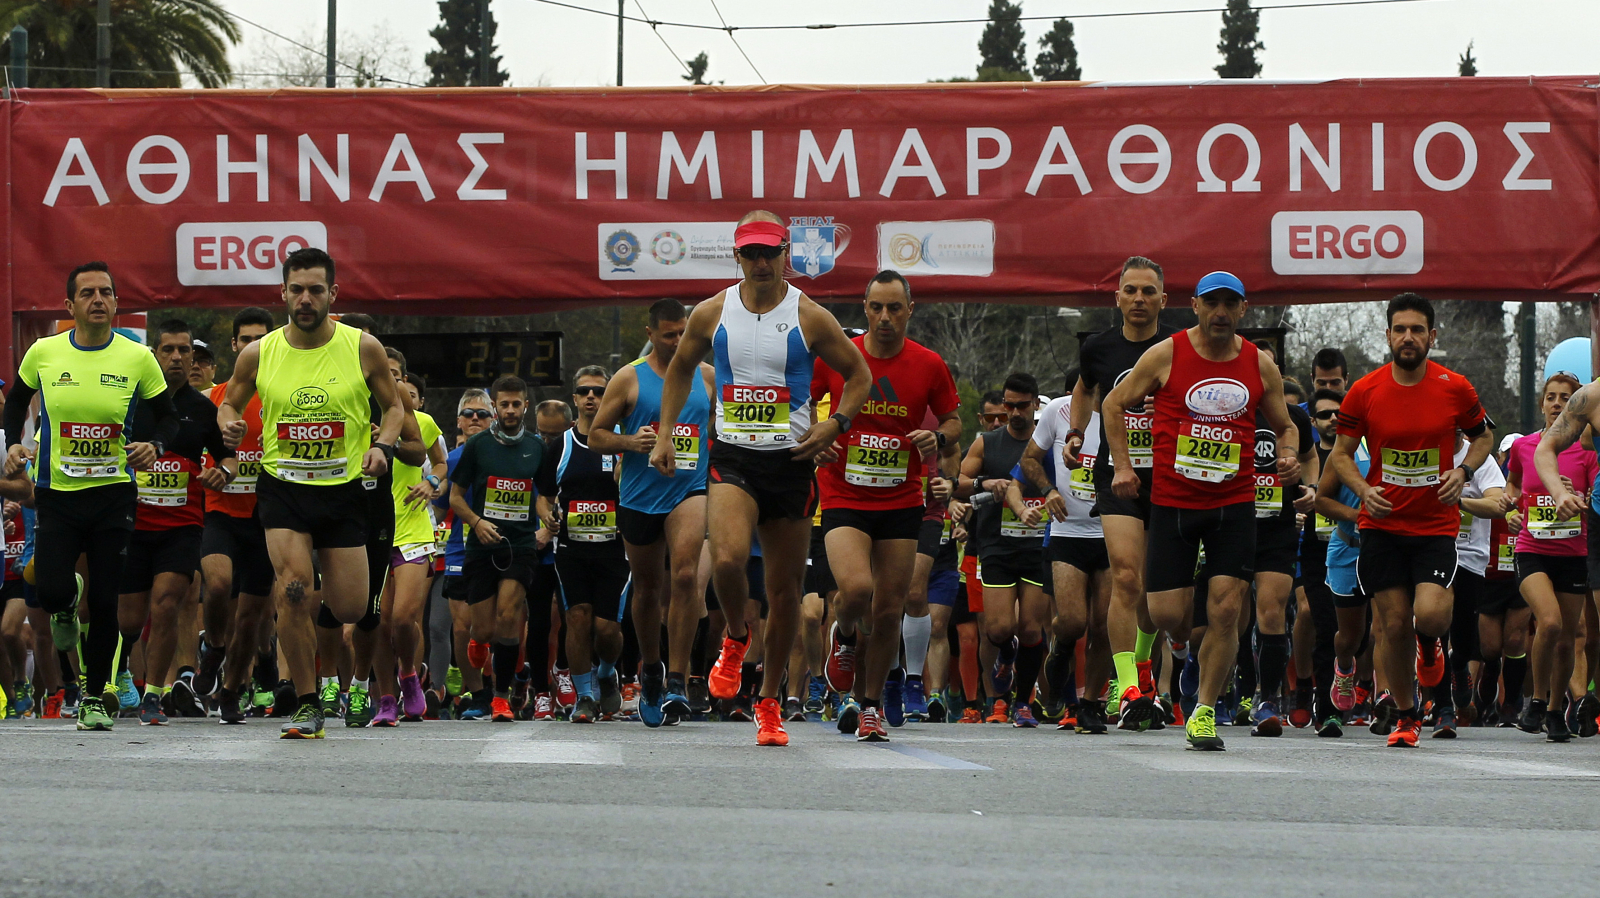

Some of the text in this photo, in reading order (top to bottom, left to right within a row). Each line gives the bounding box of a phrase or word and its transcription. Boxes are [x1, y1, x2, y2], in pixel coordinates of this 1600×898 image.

[43, 122, 1553, 207] ΑΘΗΝΑΣ ΗΜΙΜΑΡΑΘΩΝΙΟΣ
[789, 216, 834, 226] ΣΕΓΑΣ
[1289, 225, 1406, 259] ERGO
[193, 236, 310, 270] ERGO
[733, 388, 778, 403] ERGO
[734, 404, 776, 423] 4019
[860, 400, 908, 417] didas
[1227, 407, 1248, 421] TEAM
[71, 425, 111, 439] ERGO
[288, 424, 333, 440] ERGO
[1190, 423, 1232, 443] ERGO
[69, 440, 111, 456] 2082
[860, 433, 901, 449] ERGO
[237, 450, 264, 461] RGO
[289, 441, 334, 460] 2227
[857, 448, 899, 467] 2584
[1187, 439, 1231, 461] 2874
[147, 461, 181, 472] RGO
[1391, 450, 1428, 468] 2374
[146, 473, 179, 488] 3153
[496, 479, 526, 491] ERGO
[1253, 475, 1275, 487] GO
[493, 490, 525, 505] 2044
[576, 502, 608, 513] ERGO
[576, 513, 607, 527] 2819
